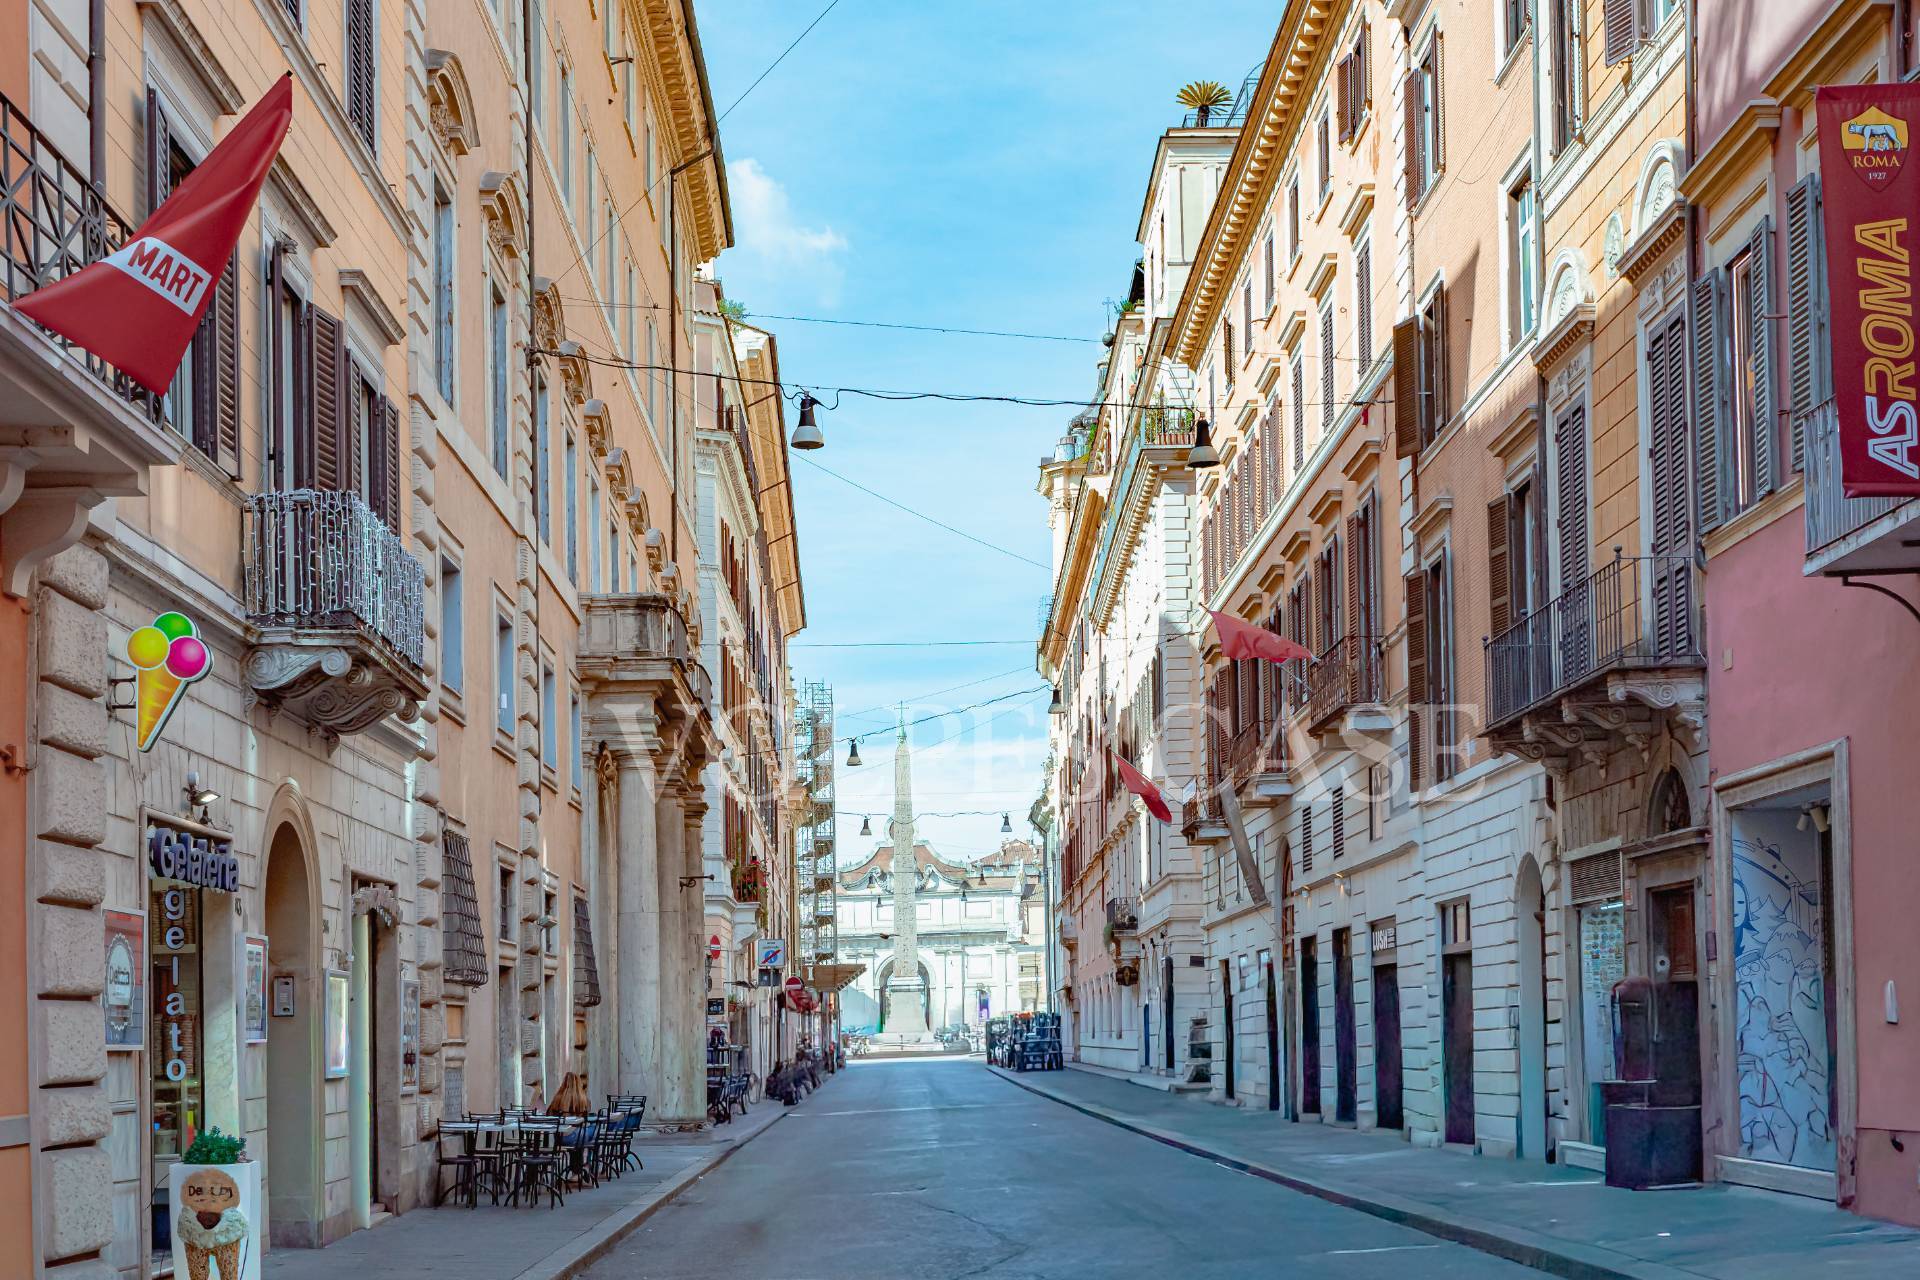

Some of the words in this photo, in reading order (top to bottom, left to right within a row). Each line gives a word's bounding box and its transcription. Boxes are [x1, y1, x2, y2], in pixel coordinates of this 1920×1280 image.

[1853, 155, 1901, 168] ROMA
[1868, 172, 1887, 180] 1927
[128, 241, 204, 304] MART
[155, 827, 239, 892] Gelateria
[1372, 929, 1388, 951] LUSH
[165, 890, 187, 1082] gelato
